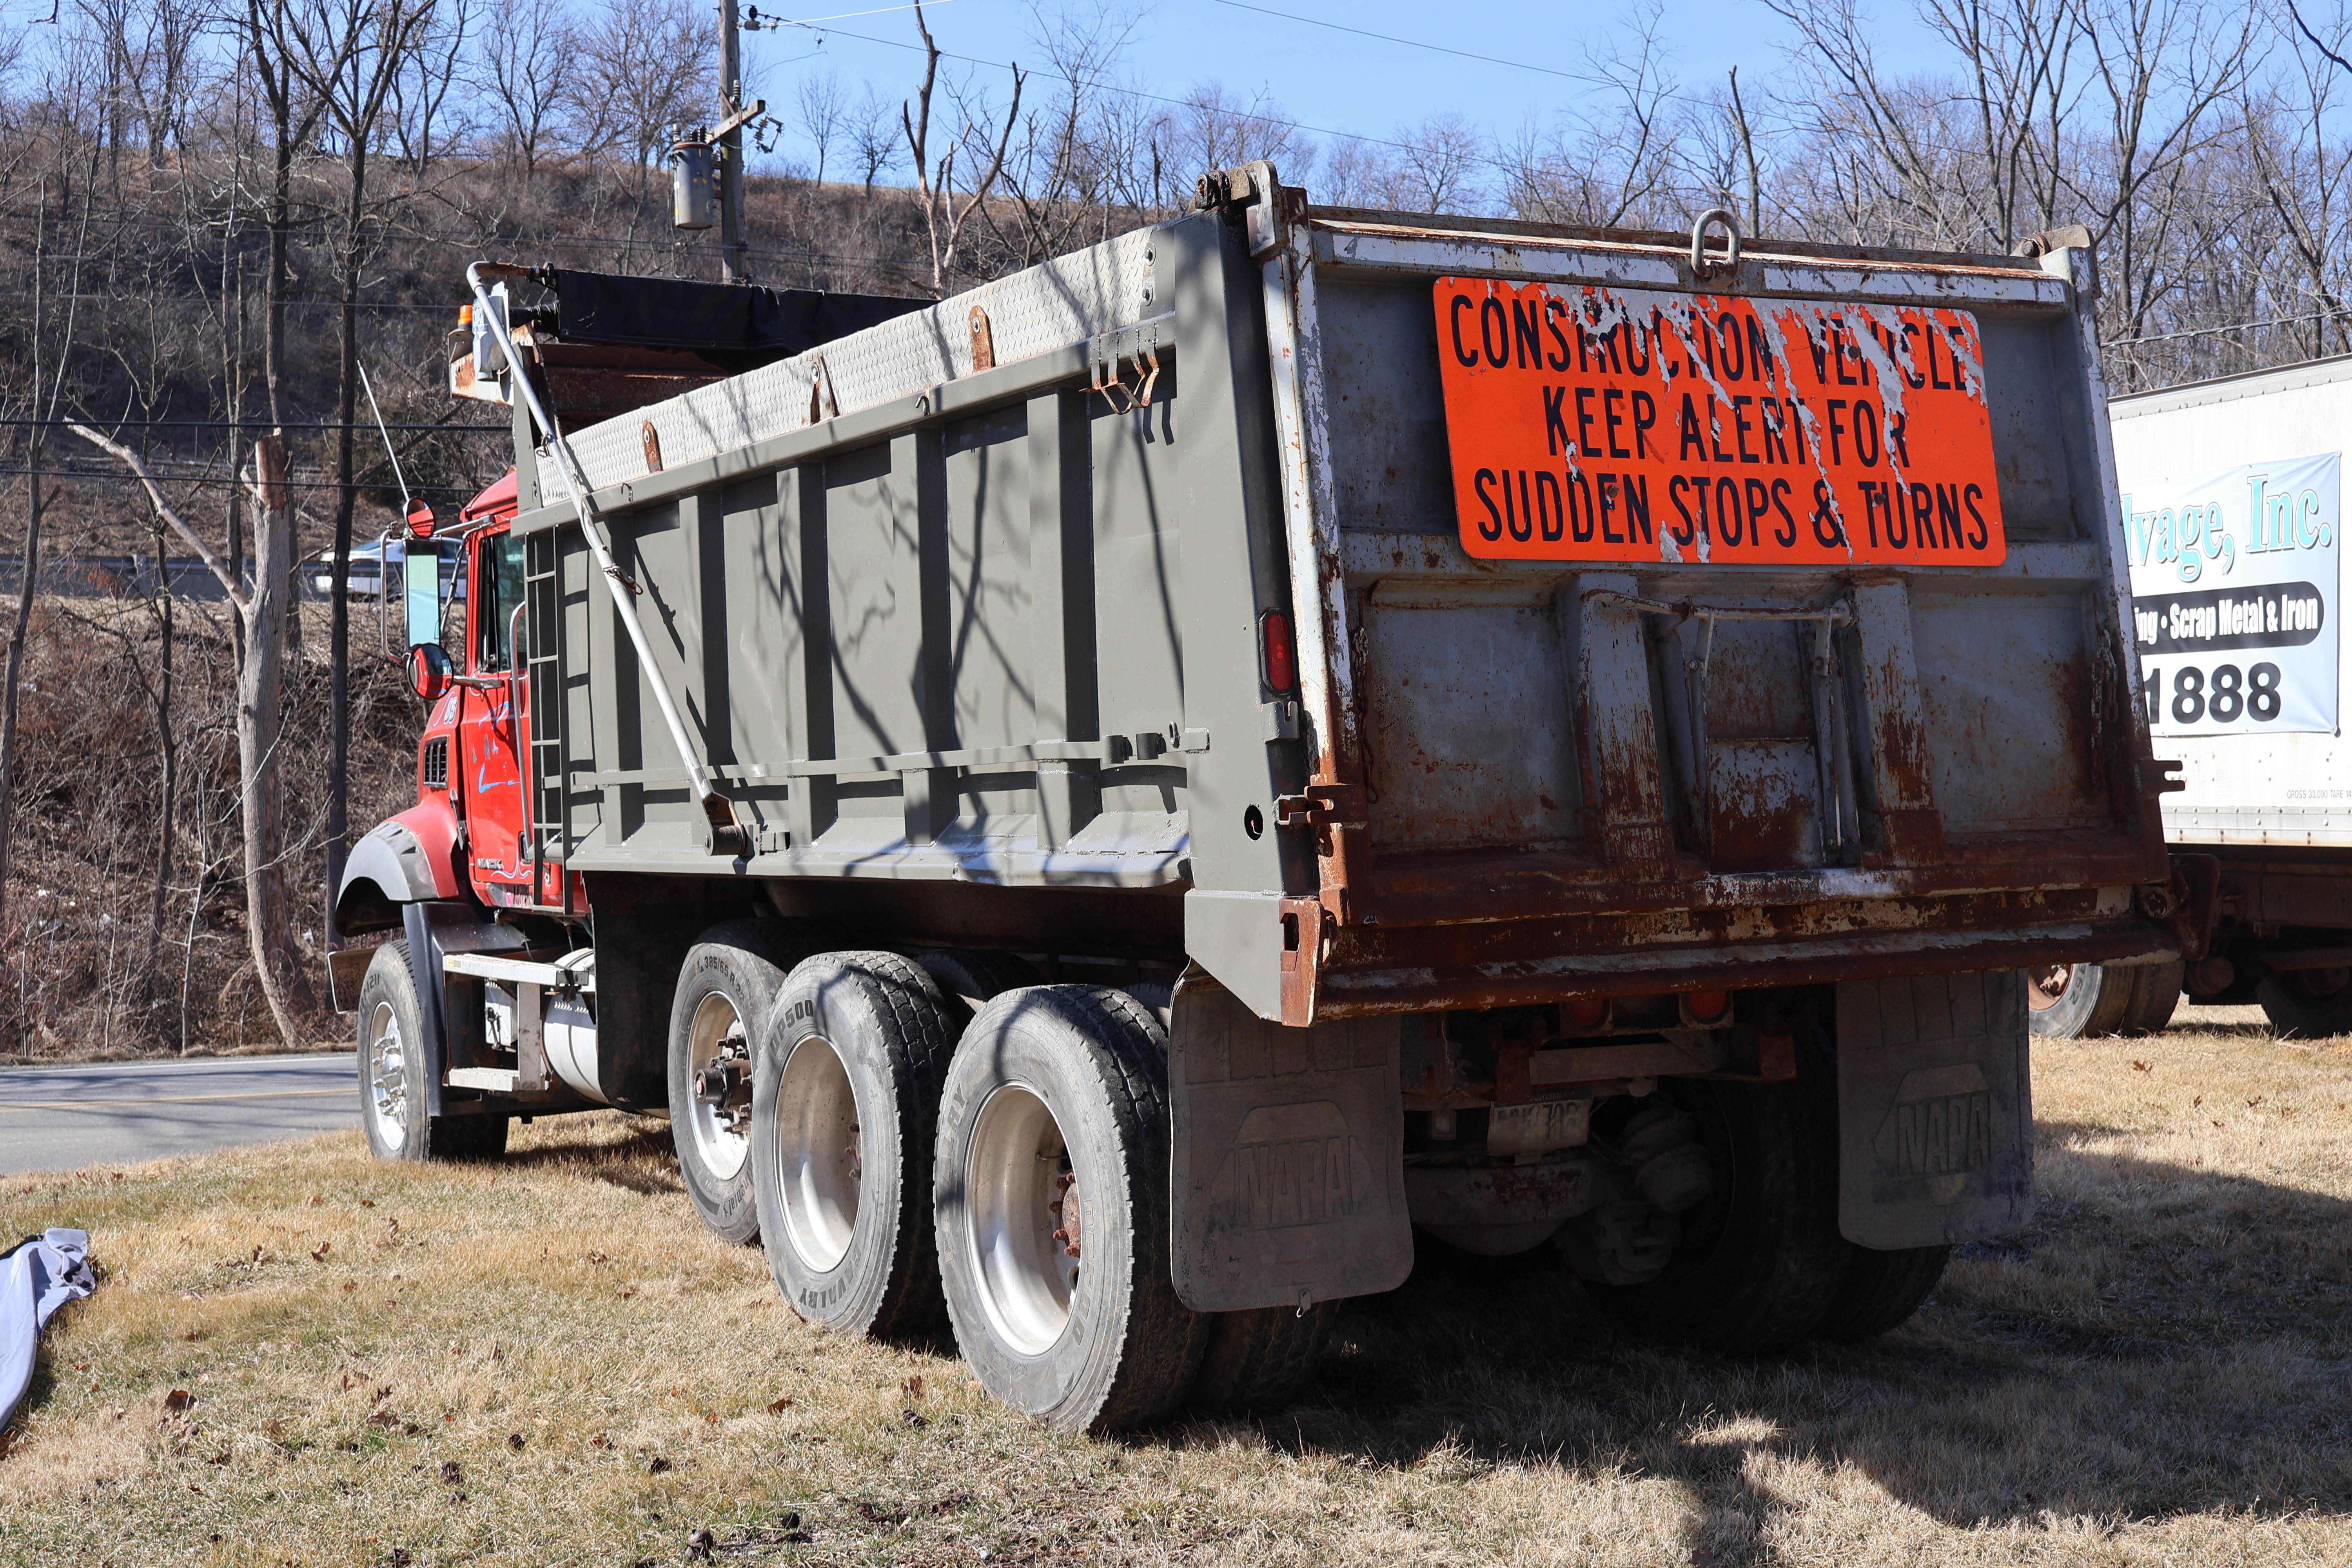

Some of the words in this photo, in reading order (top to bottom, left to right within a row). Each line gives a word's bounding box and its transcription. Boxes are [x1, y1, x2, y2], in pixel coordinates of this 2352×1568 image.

[1451, 294, 1775, 382] CONSTRUCTION
[1804, 318, 1967, 390] VEHICLE
[1543, 385, 1656, 459] KEEP
[1680, 393, 1806, 465] ALERT
[1826, 399, 1910, 468] FOR
[1474, 468, 1653, 544] SUDDEN
[1669, 474, 1797, 547] STOPS
[1812, 479, 1847, 548] &
[1858, 481, 1988, 550] TURNS
[2246, 474, 2332, 554] Inc.
[2169, 603, 2216, 640] Scrap
[2218, 596, 2264, 635] Metal
[2266, 600, 2280, 632] &
[2281, 594, 2318, 631] Iron
[2287, 789, 2307, 799] GROSS
[2308, 789, 2328, 800] 33,000
[2330, 789, 2343, 799] TARE
[704, 955, 729, 977] 385/65
[1530, 1091, 1567, 1102] SYLVANIA
[1897, 1096, 1987, 1176] NAPA
[1238, 1136, 1349, 1226] NAPA
[799, 1242, 862, 1309] CAVALRY
